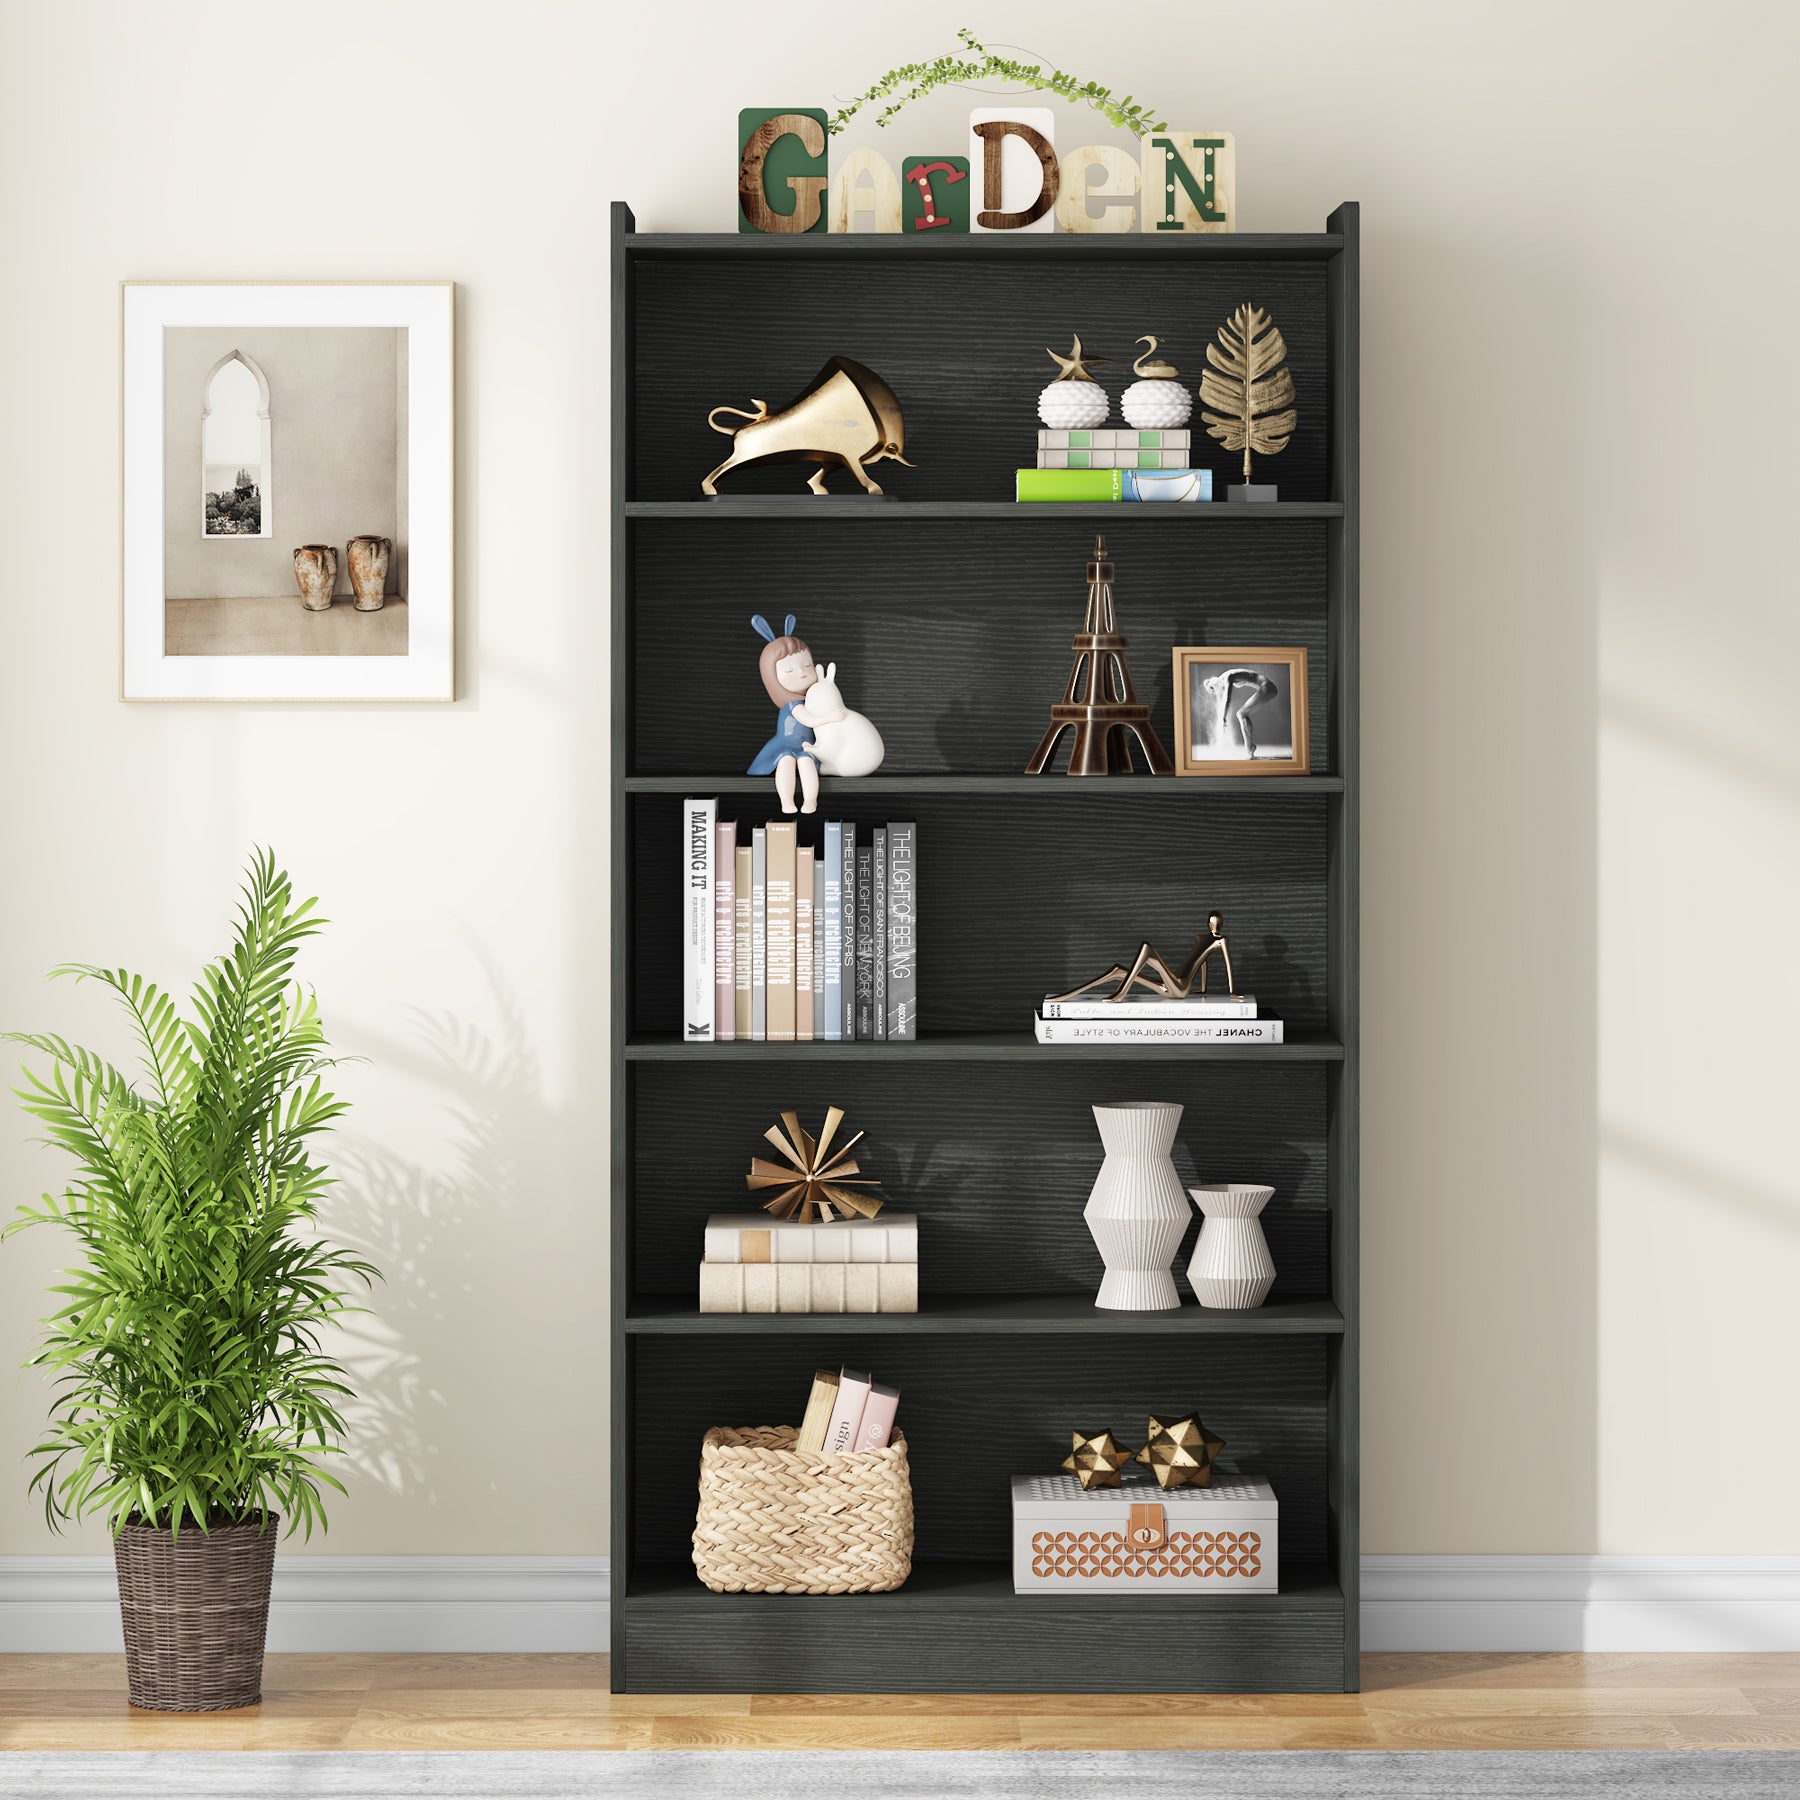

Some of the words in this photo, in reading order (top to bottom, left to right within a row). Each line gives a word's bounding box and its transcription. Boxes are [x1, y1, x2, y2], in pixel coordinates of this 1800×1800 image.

[691, 811, 707, 870] MAKING
[844, 830, 854, 858] THE
[876, 836, 884, 858] THE
[893, 830, 910, 858] THE
[860, 854, 870, 876] THE
[876, 859, 884, 890] LIGHT
[691, 874, 707, 890] IT
[716, 880, 734, 902] arts
[753, 885, 765, 906] arts
[767, 880, 795, 902] arts
[825, 880, 841, 902] arts
[844, 860, 854, 901] LIGHT
[893, 860, 910, 901] LIGHT
[736, 898, 752, 917] arts
[797, 899, 812, 918] arts
[860, 880, 870, 914] LIGHT
[876, 892, 884, 908] OF
[814, 908, 824, 926] arts
[844, 904, 854, 923] OF
[860, 916, 870, 932] OF
[876, 908, 884, 932] SAN
[893, 903, 910, 923] OF
[716, 920, 734, 984] architecture
[736, 932, 752, 990] architecture
[753, 922, 765, 986] architecture
[767, 920, 795, 984] architecture
[825, 920, 841, 984] architecture
[844, 926, 854, 966] PARIS
[860, 934, 870, 964] NEW
[893, 926, 910, 978] BEIJING
[797, 933, 812, 991] architecture
[814, 940, 824, 994] architecture
[876, 934, 884, 998] FRANCISCO
[860, 964, 870, 998] YORK
[688, 1022, 710, 1035] K
[898, 1002, 906, 1035] ASSOULINE
[834, 1423, 848, 1454] sign
